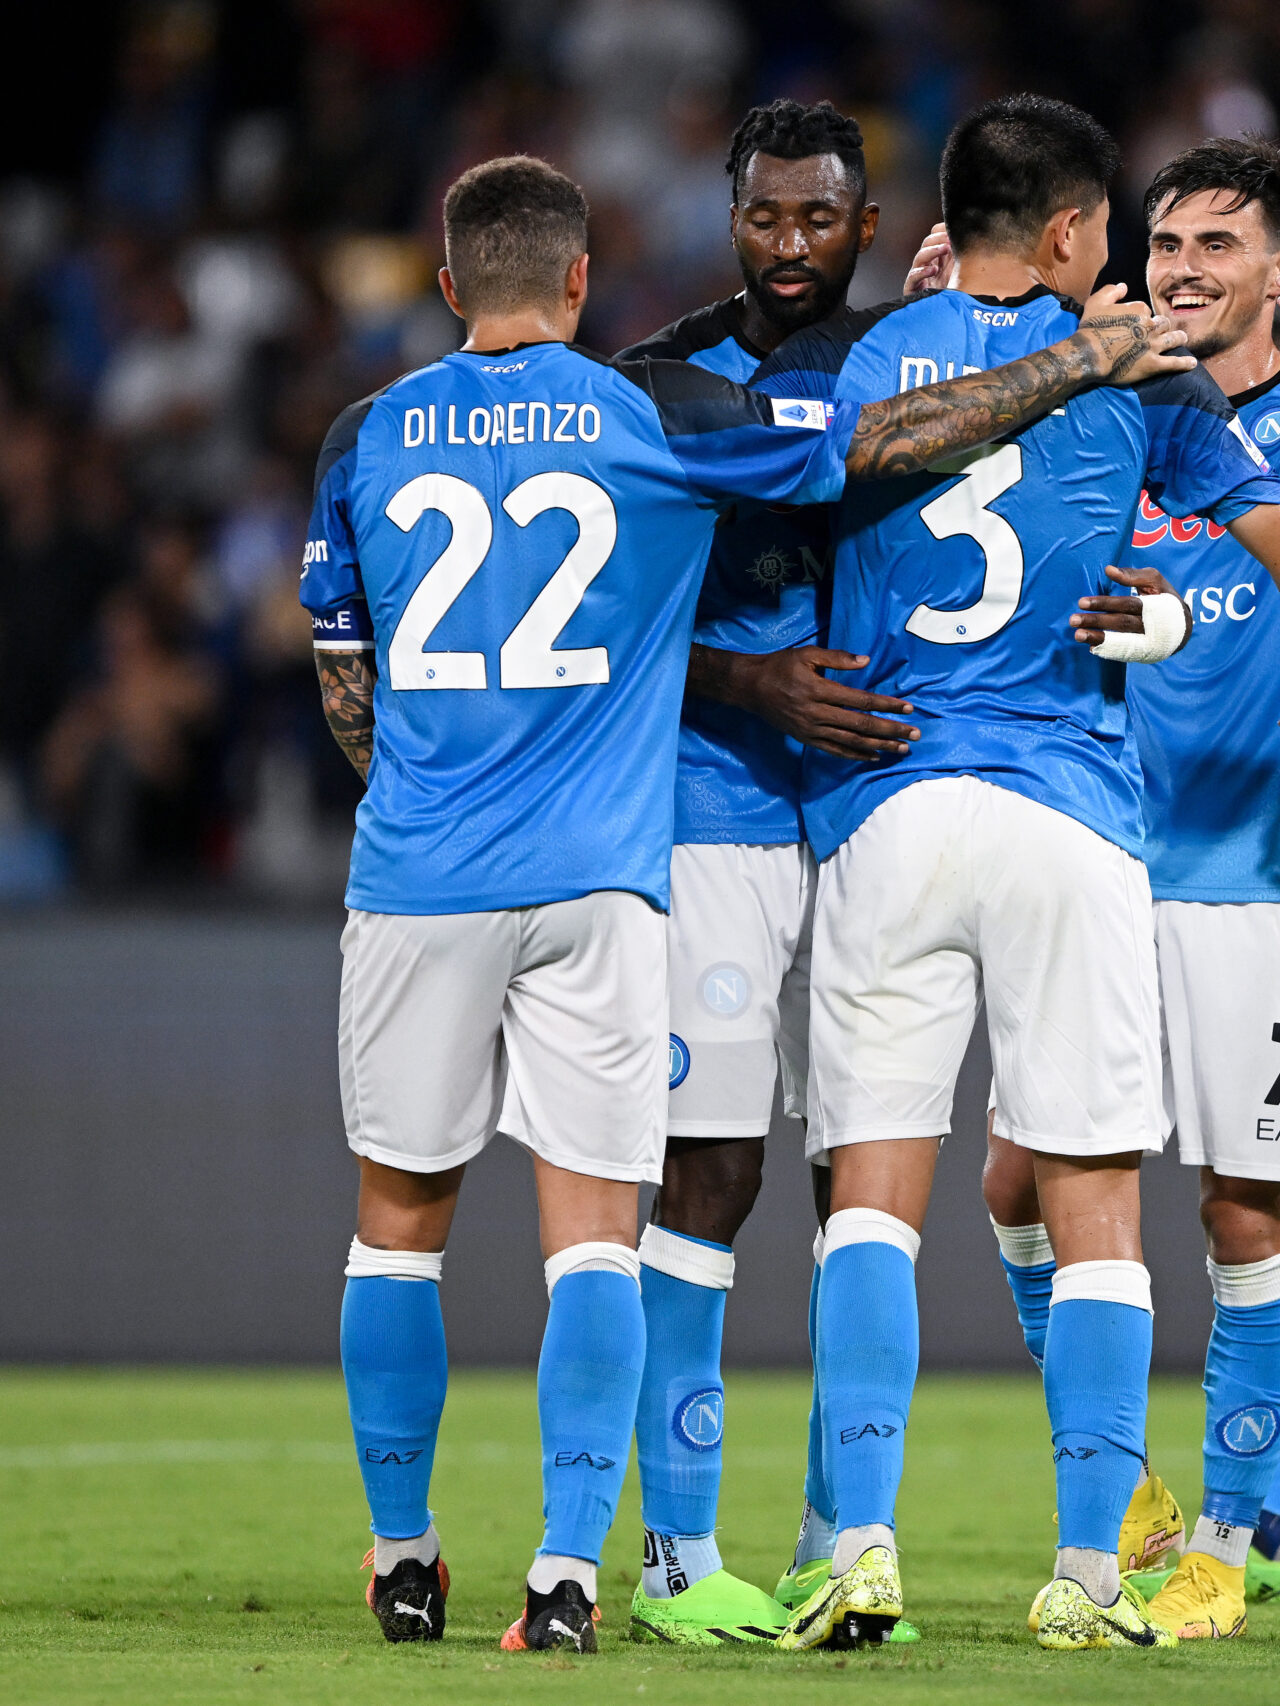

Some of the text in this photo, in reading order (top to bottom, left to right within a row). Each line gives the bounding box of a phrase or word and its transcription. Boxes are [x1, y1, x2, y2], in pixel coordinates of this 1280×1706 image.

[973, 309, 1019, 326] SSCN
[480, 360, 529, 374] SSCN
[403, 401, 601, 448] DI LORENZO
[905, 442, 1024, 644] 3
[384, 471, 618, 691] 22
[840, 1423, 898, 1445] EA7
[365, 1447, 425, 1465] EA7
[554, 1451, 617, 1471] EA7
[1215, 1526, 1230, 1539] 12
